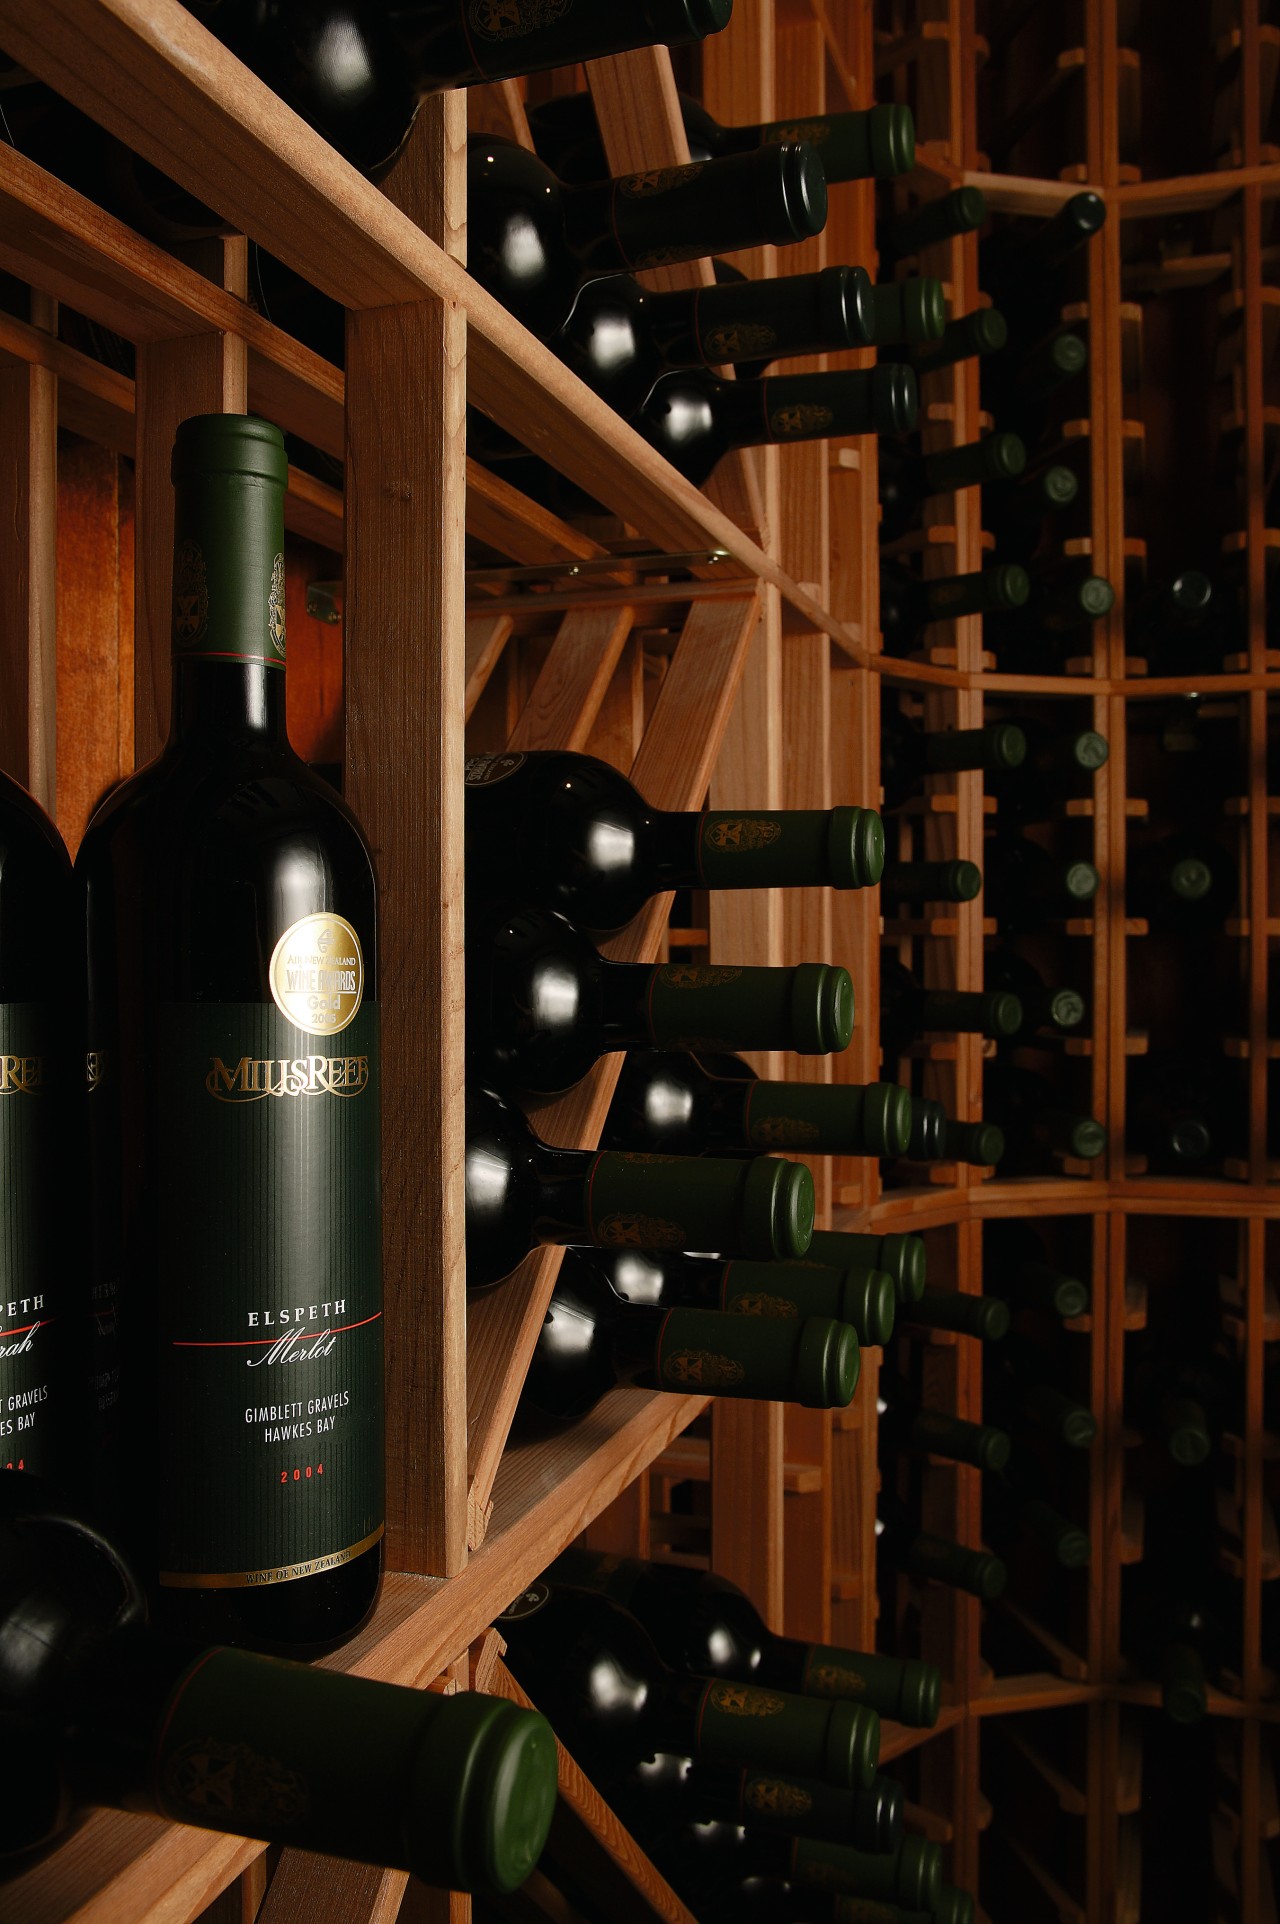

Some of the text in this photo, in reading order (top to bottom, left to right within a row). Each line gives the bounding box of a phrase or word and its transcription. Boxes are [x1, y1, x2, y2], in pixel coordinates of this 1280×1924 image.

[304, 954, 325, 965] NEW
[286, 969, 356, 991] WINE AWARDS
[307, 993, 341, 1010] Gold
[247, 1299, 346, 1327] ELSPETH
[246, 1326, 337, 1367] Merlot
[8, 1384, 48, 1411] GRAVELS
[245, 1390, 349, 1423] GIMBLETT GRAVELS
[18, 1411, 35, 1431] BAY
[264, 1415, 336, 1442] HAWKES BAY
[280, 1463, 324, 1483] 2004
[246, 1550, 351, 1584] WINE OF NEW ZEALAND
